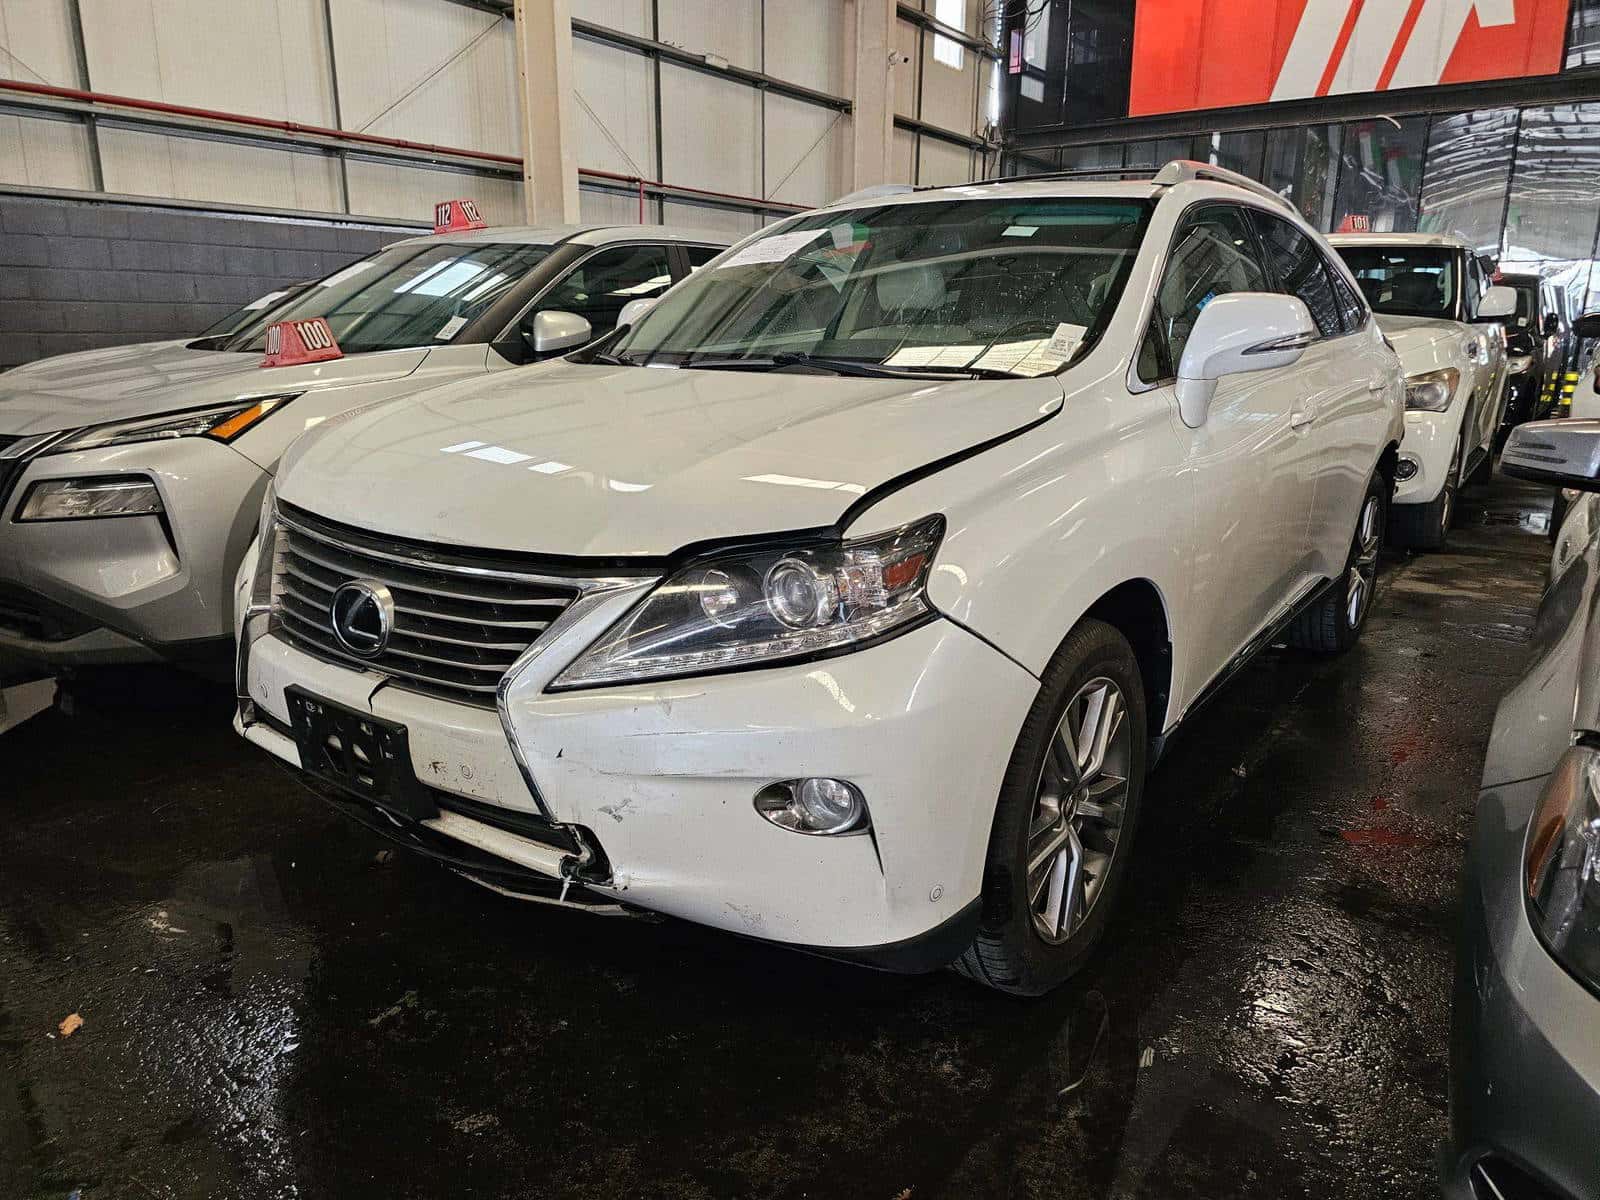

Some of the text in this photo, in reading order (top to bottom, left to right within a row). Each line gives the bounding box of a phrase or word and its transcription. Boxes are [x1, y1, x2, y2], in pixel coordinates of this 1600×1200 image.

[438, 203, 451, 226] 112
[461, 201, 481, 221] 112
[268, 325, 280, 355] 100
[296, 320, 332, 350] 100
